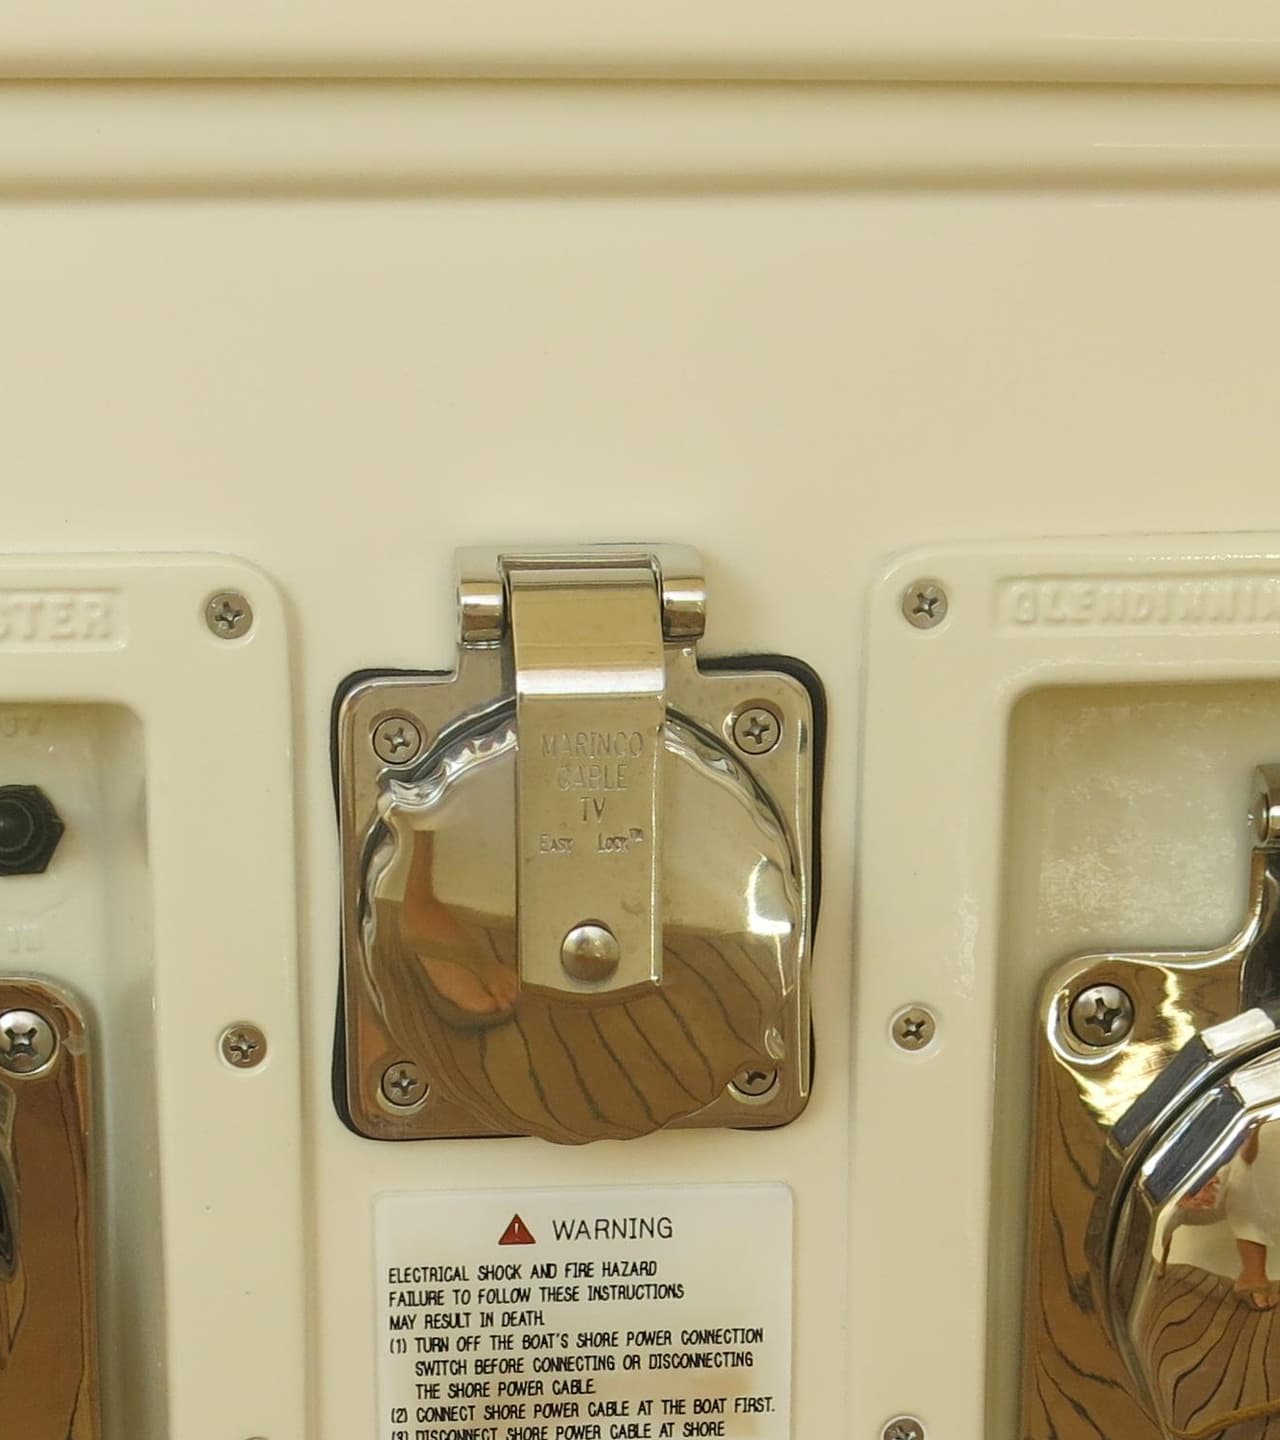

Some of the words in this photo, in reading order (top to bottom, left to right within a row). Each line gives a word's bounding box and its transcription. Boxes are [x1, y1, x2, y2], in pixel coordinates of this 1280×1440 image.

[541, 731, 644, 759] MARINCO
[557, 763, 629, 791] CABLE
[579, 796, 607, 823] TV
[551, 1216, 673, 1241] WARNING
[388, 1265, 470, 1285] ELECTRICAL
[476, 1263, 523, 1282] SHOCK
[529, 1262, 558, 1280] AND
[564, 1261, 595, 1279] FIRE
[601, 1260, 658, 1278] HAZARD
[388, 1289, 445, 1308] FAILURE
[451, 1288, 472, 1306] TO
[477, 1287, 532, 1305] FOLLOW
[538, 1285, 580, 1303] THESE
[587, 1282, 685, 1302] INSTRUCTIONS
[389, 1313, 418, 1331] MAY
[423, 1311, 472, 1330] RESULT
[479, 1311, 494, 1329] IN
[389, 1337, 408, 1355] (1)
[413, 1335, 450, 1354] TURN
[455, 1334, 482, 1353] OFF
[488, 1333, 515, 1351] THE
[521, 1332, 569, 1351] BOAT'S
[575, 1331, 620, 1349] SHORE
[625, 1329, 673, 1347] POWER
[680, 1327, 764, 1346] CONNECTION
[414, 1358, 468, 1377] SWITCH
[473, 1356, 525, 1376] BEFORE
[532, 1354, 616, 1374] CONNECTING
[622, 1353, 642, 1371] OR
[648, 1350, 754, 1371] DISCONNECTING
[415, 1382, 441, 1400] THE
[447, 1380, 491, 1400] SHORE
[497, 1379, 545, 1398] POWER
[390, 1407, 409, 1424] (2)
[415, 1404, 477, 1424] CONNECT
[483, 1402, 527, 1421] SHORE
[533, 1401, 580, 1420] POWER
[587, 1399, 630, 1418] CABLE
[636, 1399, 655, 1417] AT
[660, 1398, 687, 1416] THE
[692, 1397, 728, 1415] BOAT
[734, 1396, 776, 1414] FIRST.
[609, 1422, 652, 1440] CABLE
[658, 1421, 676, 1439] AT
[681, 1420, 726, 1438] SHORE
